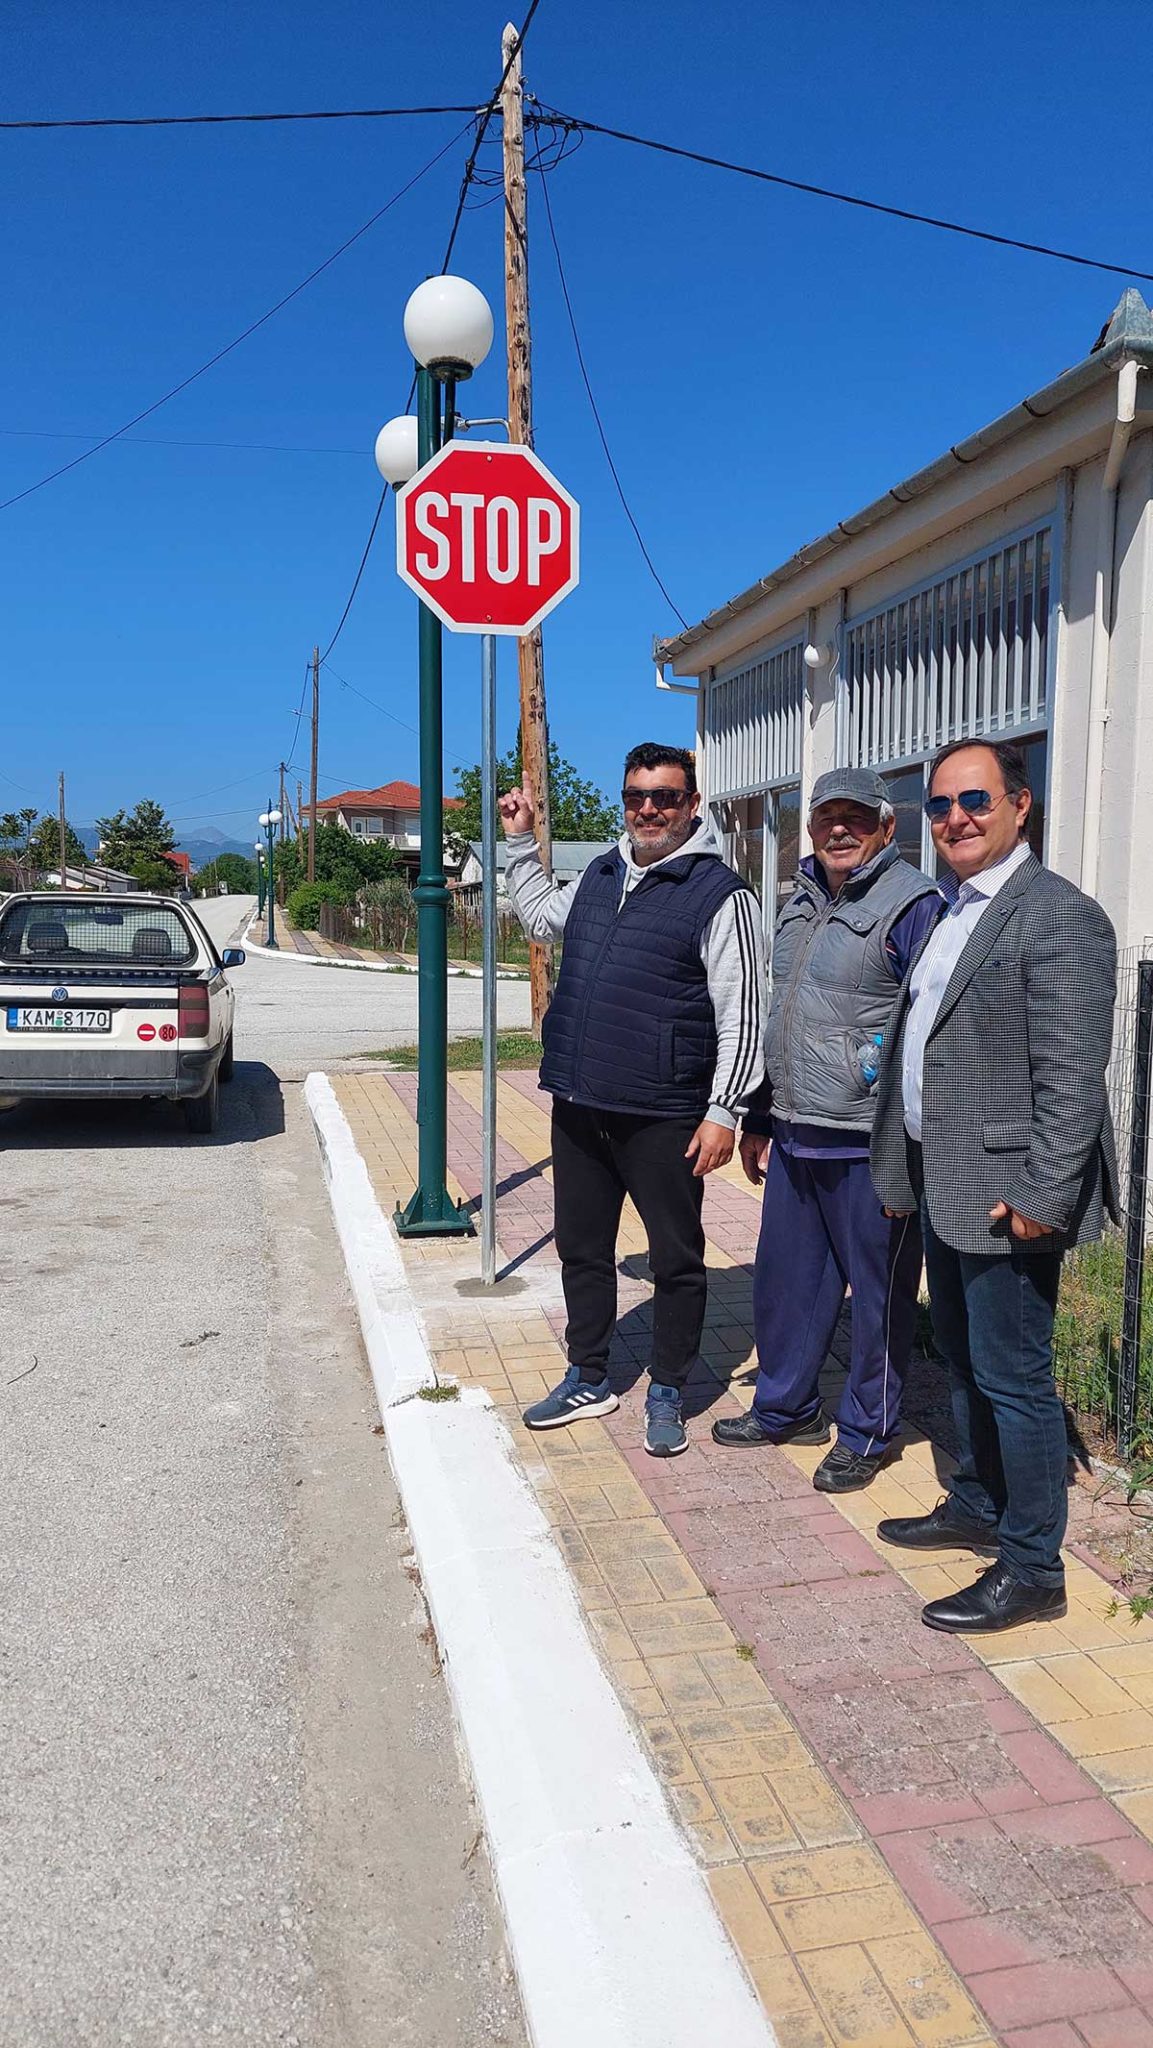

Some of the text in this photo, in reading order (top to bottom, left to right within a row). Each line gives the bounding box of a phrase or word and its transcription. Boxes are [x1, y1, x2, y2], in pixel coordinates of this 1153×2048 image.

[415, 491, 562, 587] STOP
[22, 1010, 107, 1027] KAM 8170
[162, 1026, 175, 1040] 80
